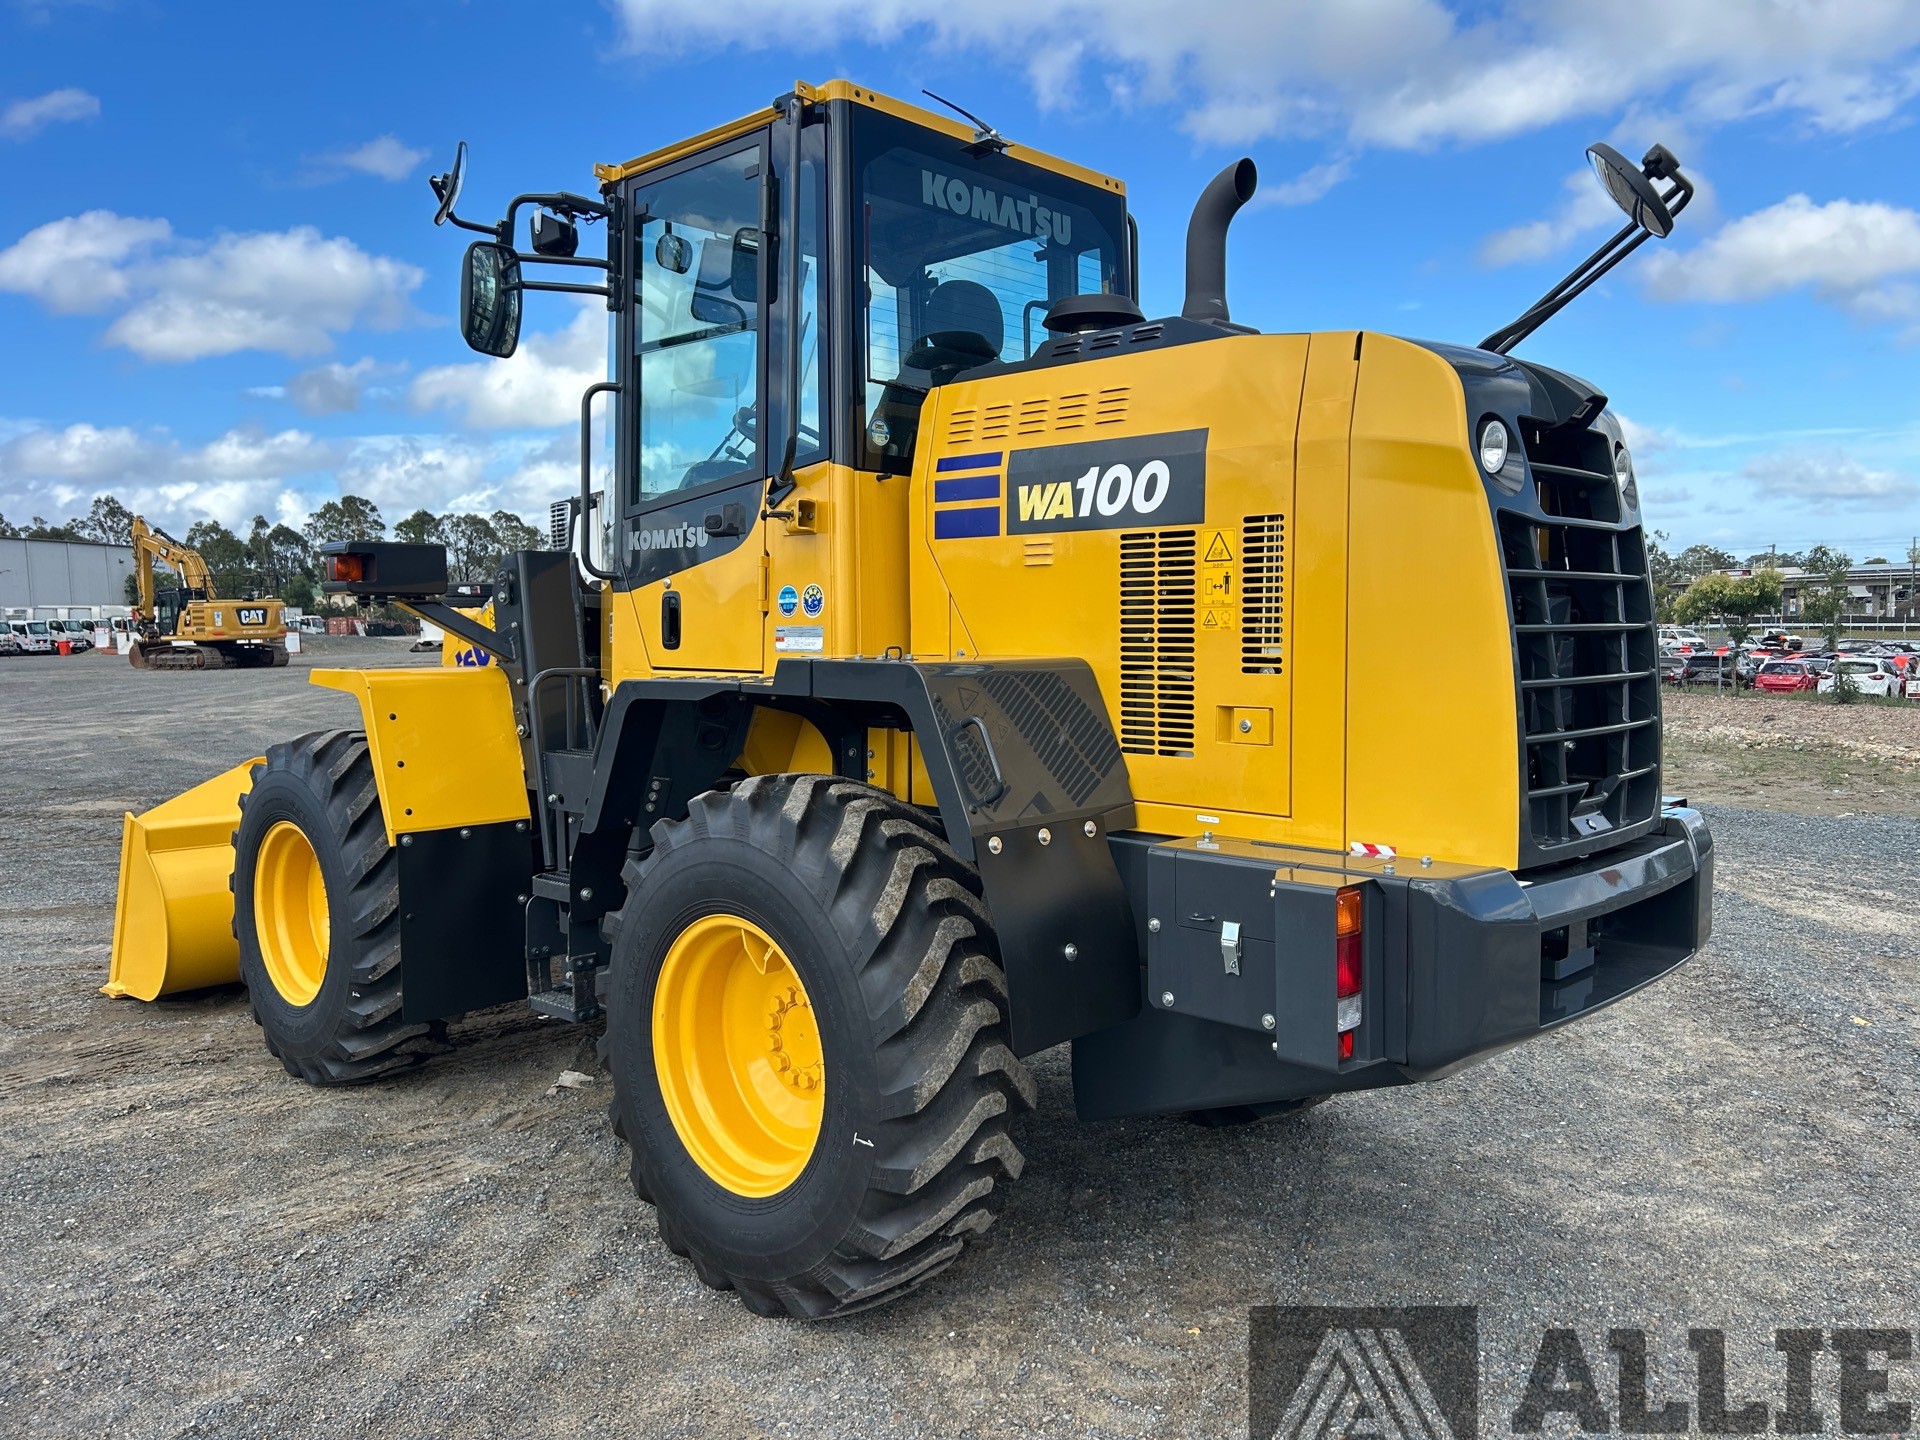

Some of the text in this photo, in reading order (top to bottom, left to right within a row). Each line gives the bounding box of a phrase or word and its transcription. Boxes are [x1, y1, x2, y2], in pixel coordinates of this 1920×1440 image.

[922, 169, 1072, 246] KOMATSU
[1018, 460, 1170, 521] WA100
[628, 521, 709, 551] KOMATSU
[240, 609, 264, 624] CAT
